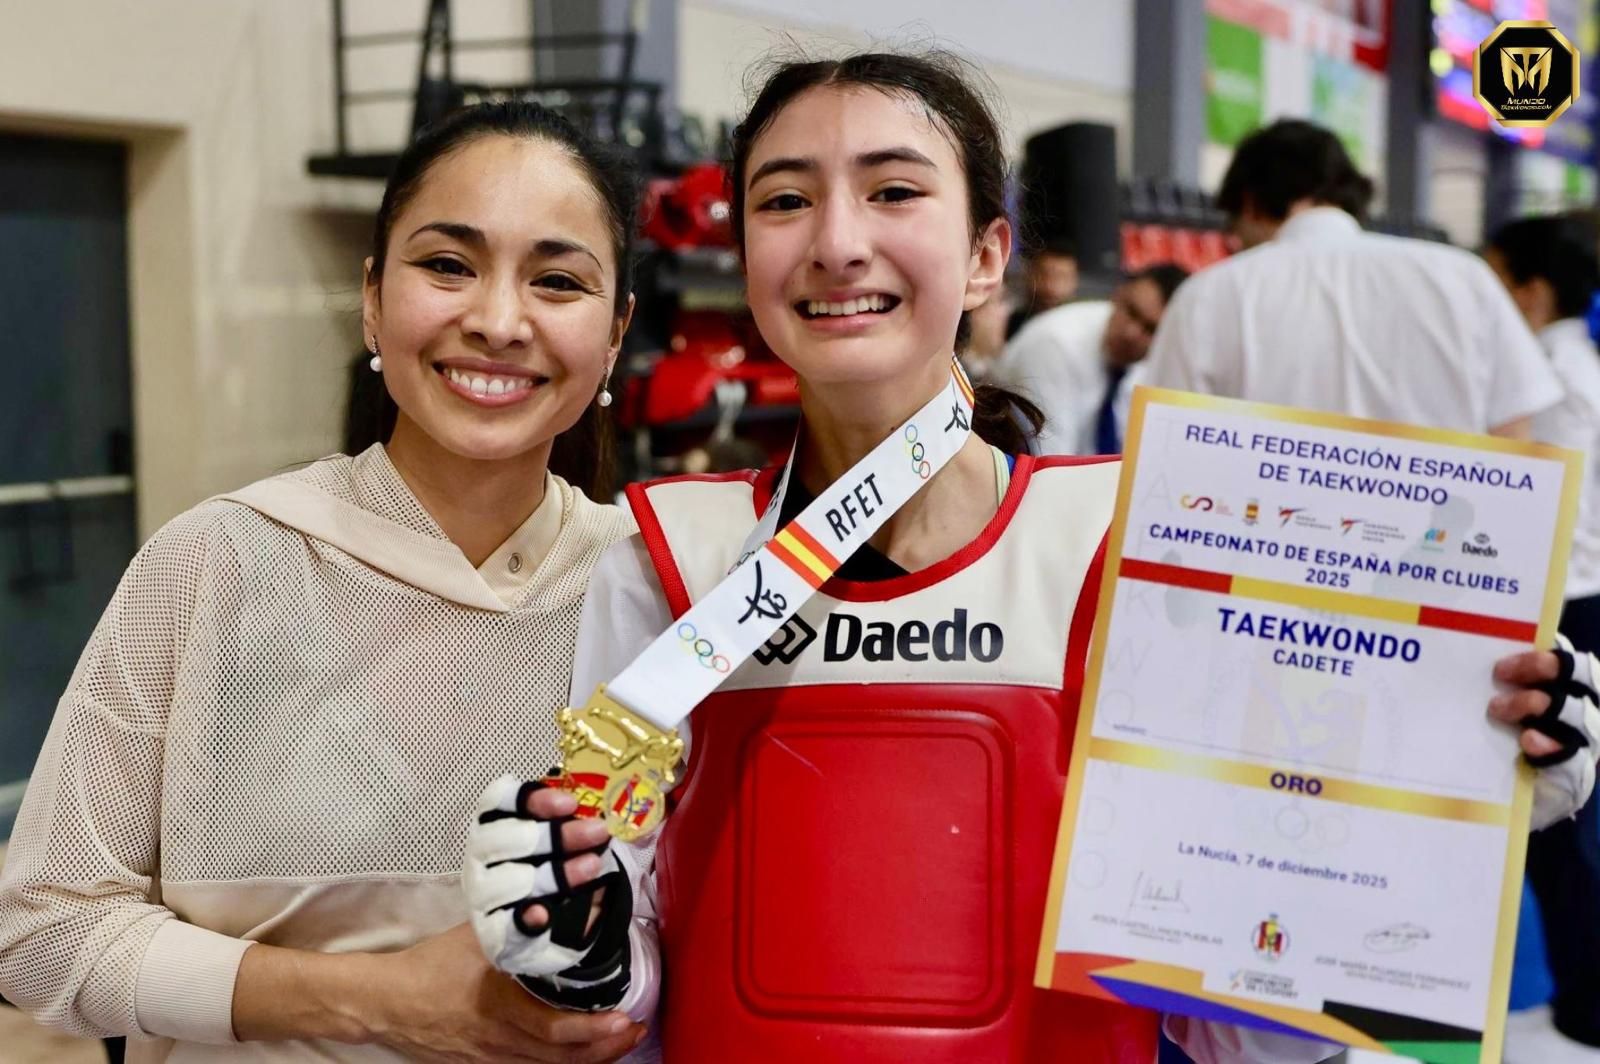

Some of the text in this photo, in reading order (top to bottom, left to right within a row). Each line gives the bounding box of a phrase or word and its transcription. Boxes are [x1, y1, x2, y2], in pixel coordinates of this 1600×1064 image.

[1185, 424, 1534, 491] REAL FEDERACIÓN ESPAÑOLA
[825, 473, 884, 542] RFET
[1259, 462, 1449, 506] DE TAEKWONDO
[1150, 523, 1520, 595] CAMPEONATO DE ESPAÑA POR CLUBES
[1461, 542, 1499, 558] Daedo
[1305, 567, 1350, 588] 2025
[823, 608, 1004, 663] Daedo
[1218, 608, 1421, 663] TAEKWONDO
[1273, 649, 1354, 677] CADETE
[1270, 772, 1323, 796] ORO
[1178, 842, 1195, 855] La
[1245, 854, 1255, 865] 7
[1257, 857, 1275, 870] de
[1277, 860, 1348, 883] diciembre
[1351, 872, 1389, 889] 2025
